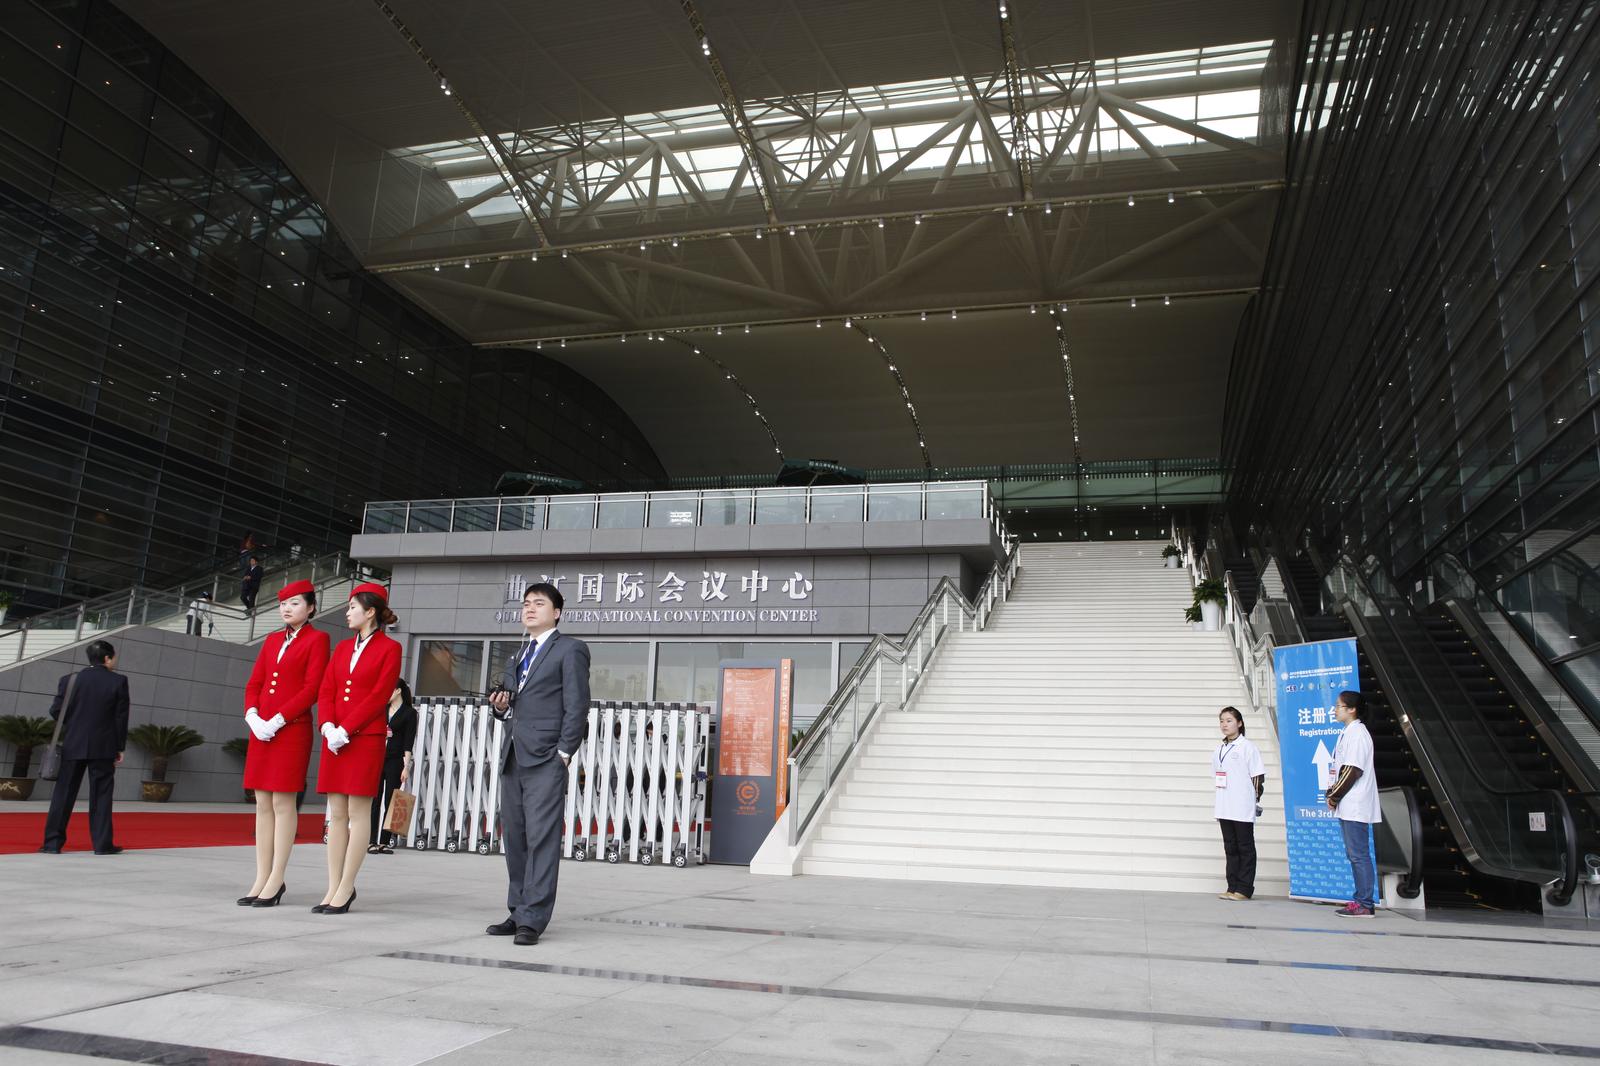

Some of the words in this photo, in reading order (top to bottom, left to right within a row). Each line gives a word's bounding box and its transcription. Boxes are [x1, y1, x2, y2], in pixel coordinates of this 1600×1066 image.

[560, 610, 661, 622] NTERNATIONAL
[664, 610, 756, 622] CONVENTION
[760, 609, 818, 622] CENTER
[1300, 808, 1316, 818] The
[1317, 809, 1333, 818] 3rd
